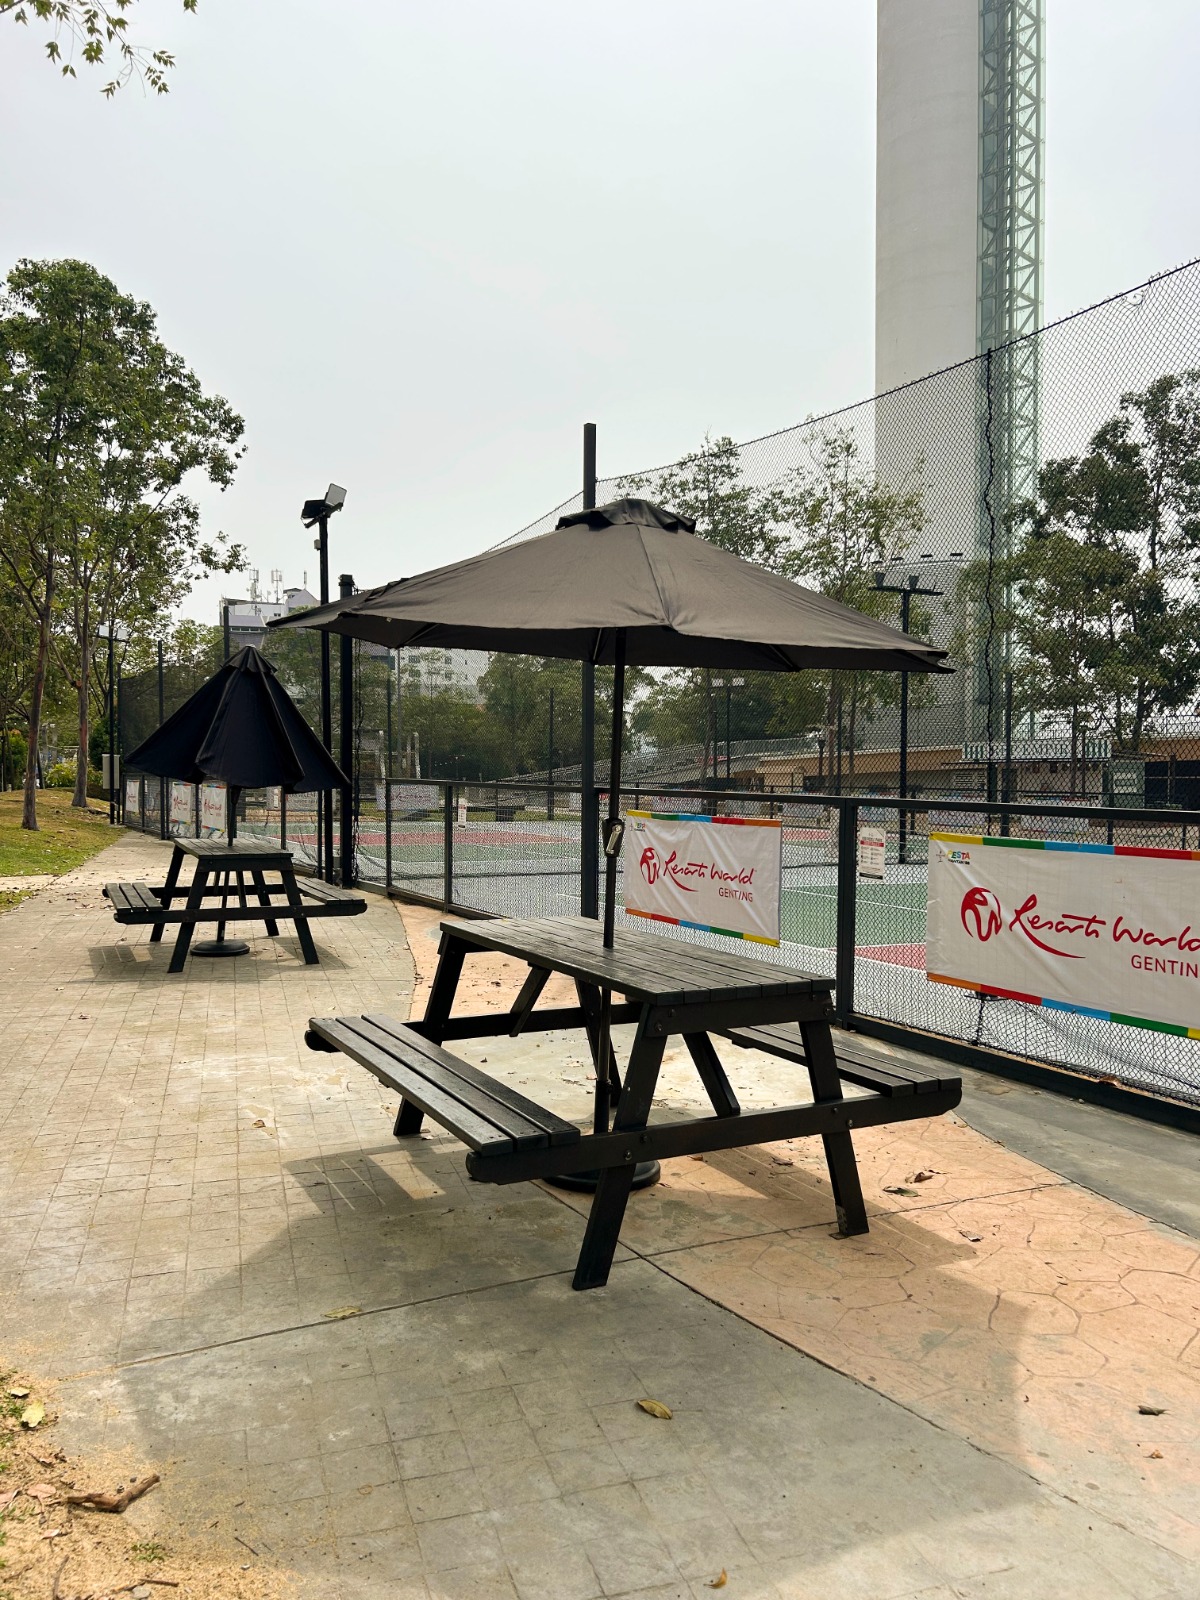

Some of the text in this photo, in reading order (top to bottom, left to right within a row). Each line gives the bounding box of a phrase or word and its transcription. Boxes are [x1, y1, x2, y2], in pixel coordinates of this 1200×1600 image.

[663, 850, 755, 892] Resorts World
[718, 887, 753, 902] GENTING
[1009, 894, 1107, 959] Resorts
[1131, 954, 1199, 979] GENTIN
